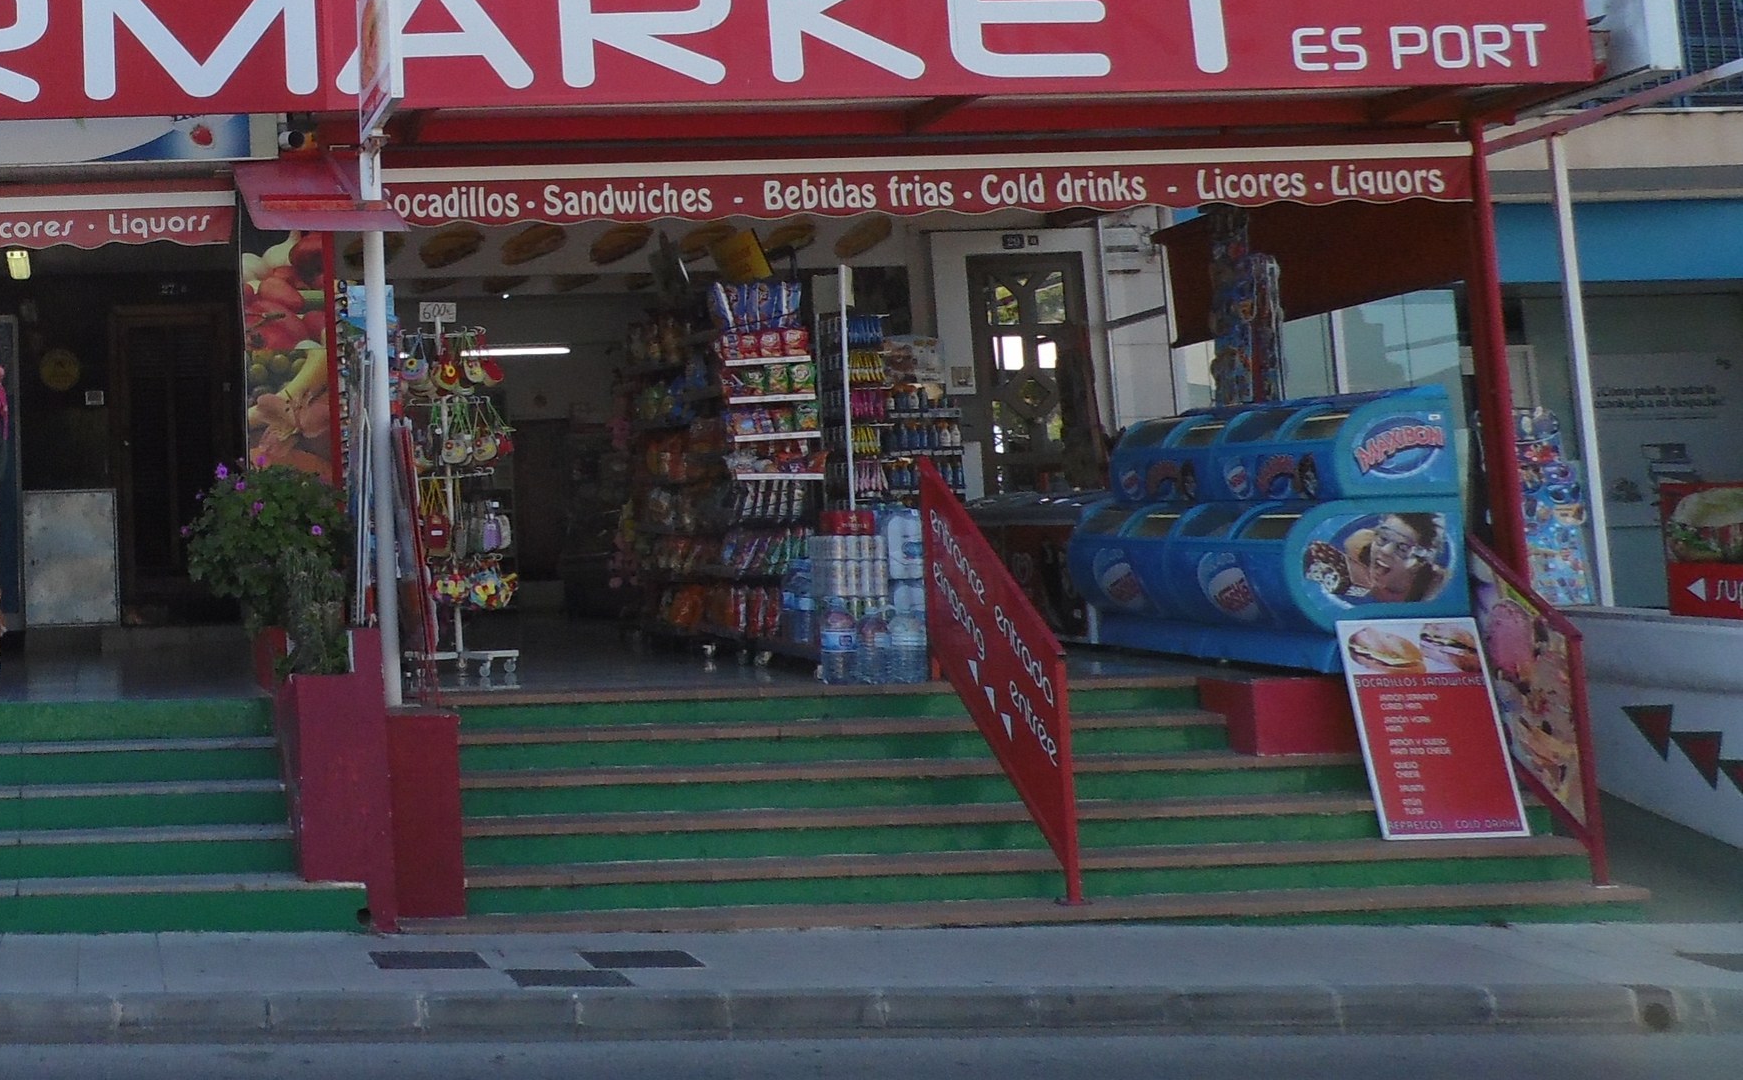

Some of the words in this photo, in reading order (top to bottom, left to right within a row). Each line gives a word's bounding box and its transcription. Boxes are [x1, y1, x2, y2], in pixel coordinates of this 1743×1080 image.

[1291, 26, 1368, 72] ES
[1390, 23, 1547, 70] PORT
[382, 185, 520, 219] ocadillos
[543, 182, 713, 217] Sandwiches
[763, 179, 877, 210] Bebidas
[888, 175, 954, 207] frias
[980, 173, 1045, 206] Cold
[1057, 169, 1147, 202] drinks
[1196, 166, 1306, 200] Licores
[1330, 163, 1445, 197] Liquors
[108, 212, 211, 236] Liquors
[930, 509, 986, 606] entrance
[994, 605, 1055, 708] entrada
[932, 561, 986, 661] eingang
[1009, 680, 1058, 767] entrée
[1354, 676, 1418, 688] BOCADILLOS
